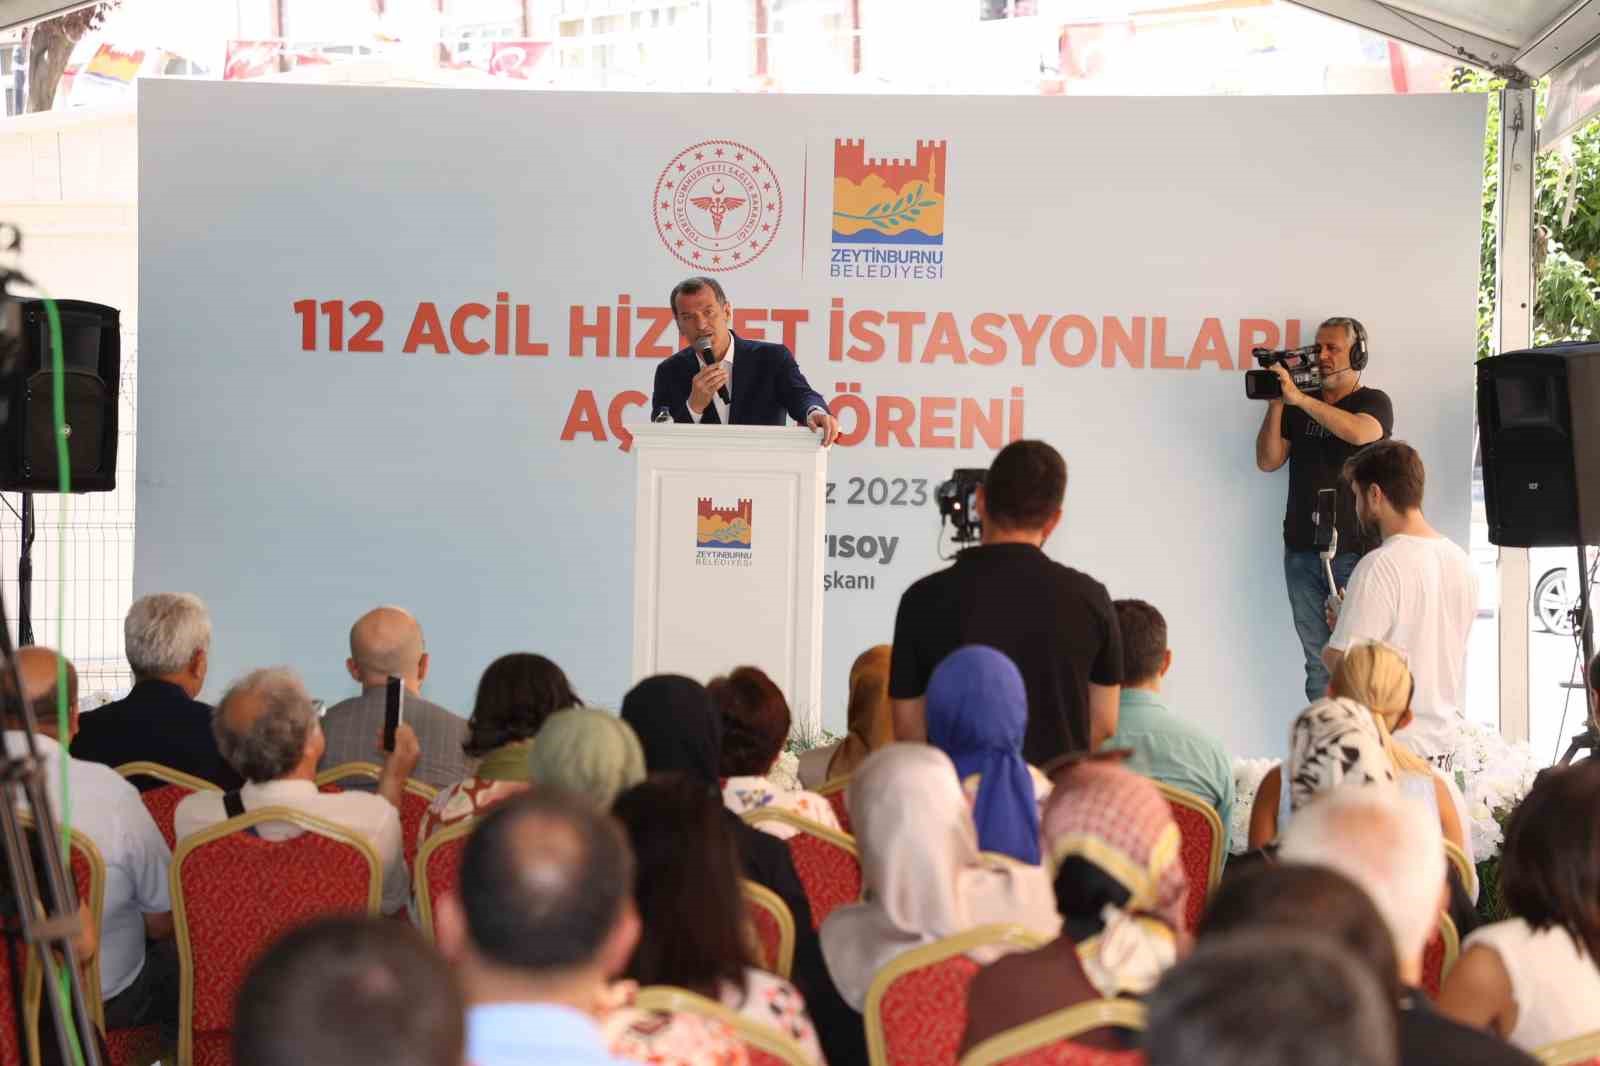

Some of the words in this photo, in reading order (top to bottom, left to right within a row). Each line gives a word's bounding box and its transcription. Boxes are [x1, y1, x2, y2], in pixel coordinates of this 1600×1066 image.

[831, 248, 944, 264] ZEYTİNBURNU
[830, 264, 943, 279] BELEDİYESİ
[294, 299, 384, 352] 112
[402, 291, 549, 356] ACİL
[568, 294, 809, 358] HİZET
[828, 382, 1025, 449] ÖRENİ
[847, 476, 929, 506] 2023
[825, 533, 900, 565] ısoy
[823, 570, 875, 591] şkanı
